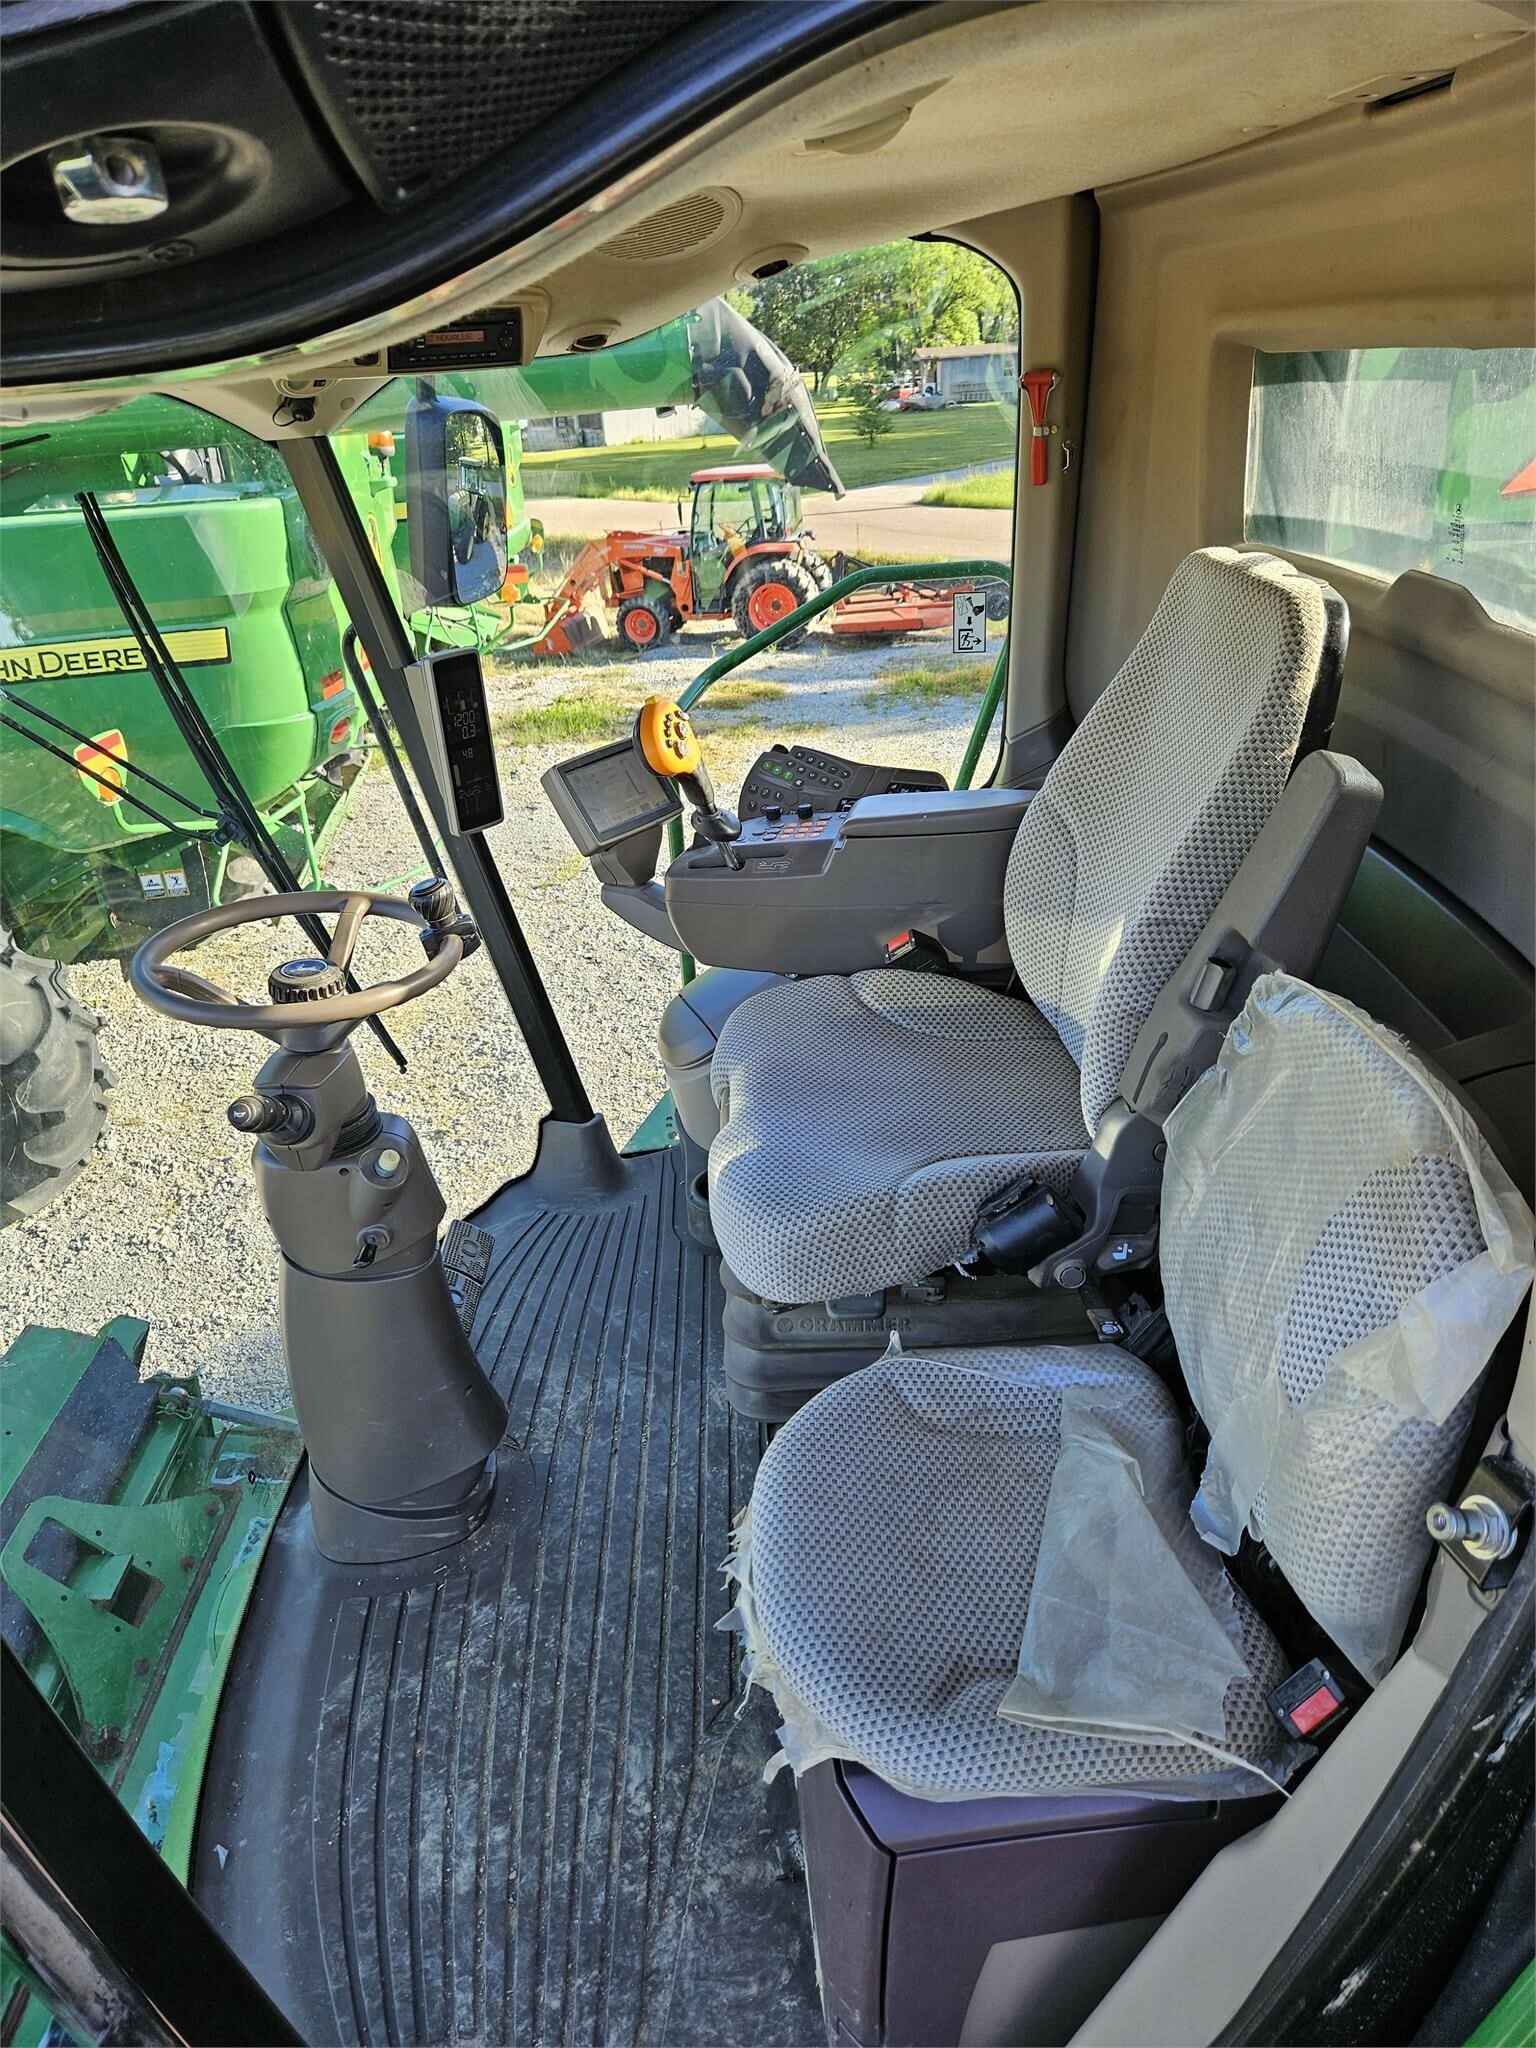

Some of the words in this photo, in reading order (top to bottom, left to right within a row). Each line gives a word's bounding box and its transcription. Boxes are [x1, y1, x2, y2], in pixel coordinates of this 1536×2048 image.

[37, 647, 143, 674] DEERE
[462, 747, 474, 759] 48
[799, 1317, 912, 1332] GRAMMER
